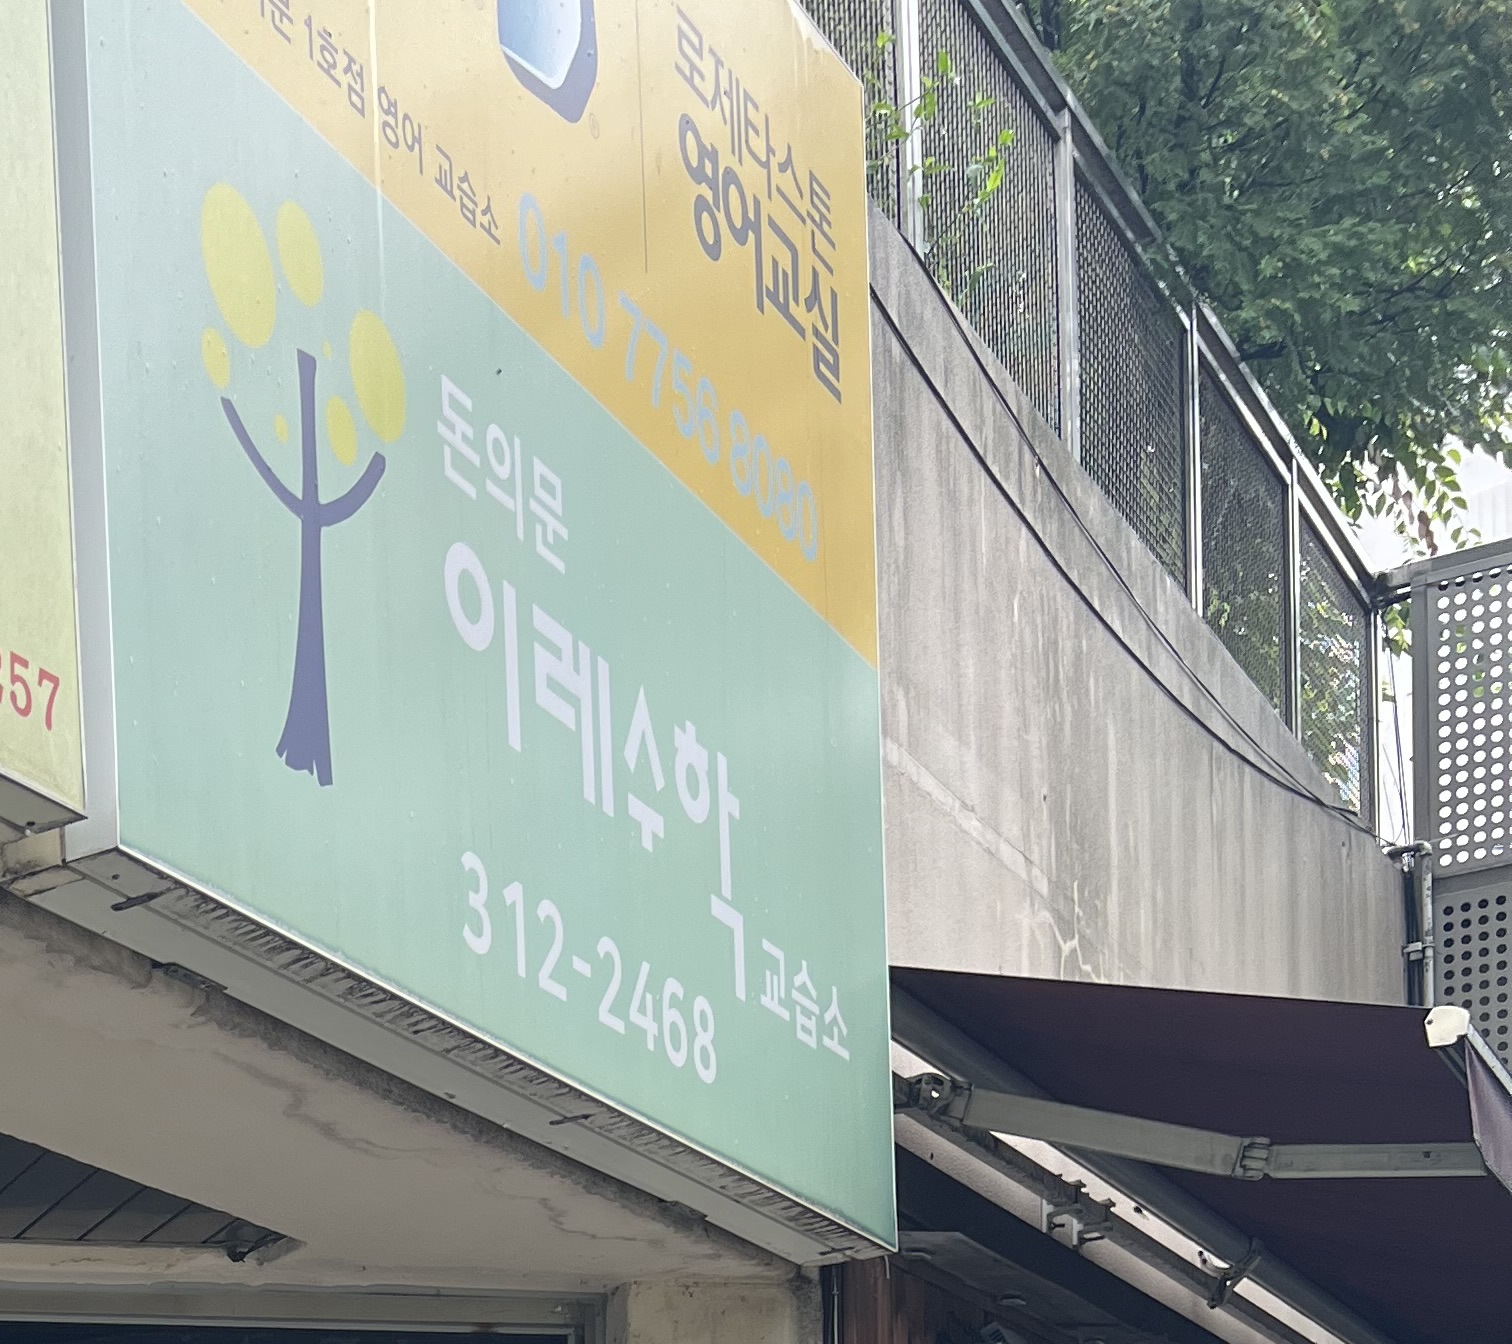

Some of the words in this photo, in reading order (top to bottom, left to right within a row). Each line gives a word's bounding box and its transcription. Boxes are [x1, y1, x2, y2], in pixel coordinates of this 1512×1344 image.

[304, 13, 365, 118] 1호점
[377, 86, 423, 175] 영어
[434, 143, 501, 245] 교습소
[674, 4, 836, 277] 로제타스톤
[678, 112, 843, 405] 영어교실
[437, 373, 569, 574] 돈의문
[518, 192, 606, 349] 010
[618, 290, 720, 466] 7756
[729, 410, 818, 562] 8080
[443, 541, 747, 1003] 이레수학
[759, 937, 851, 1061] 교습소
[461, 851, 717, 1084] 312-2468
